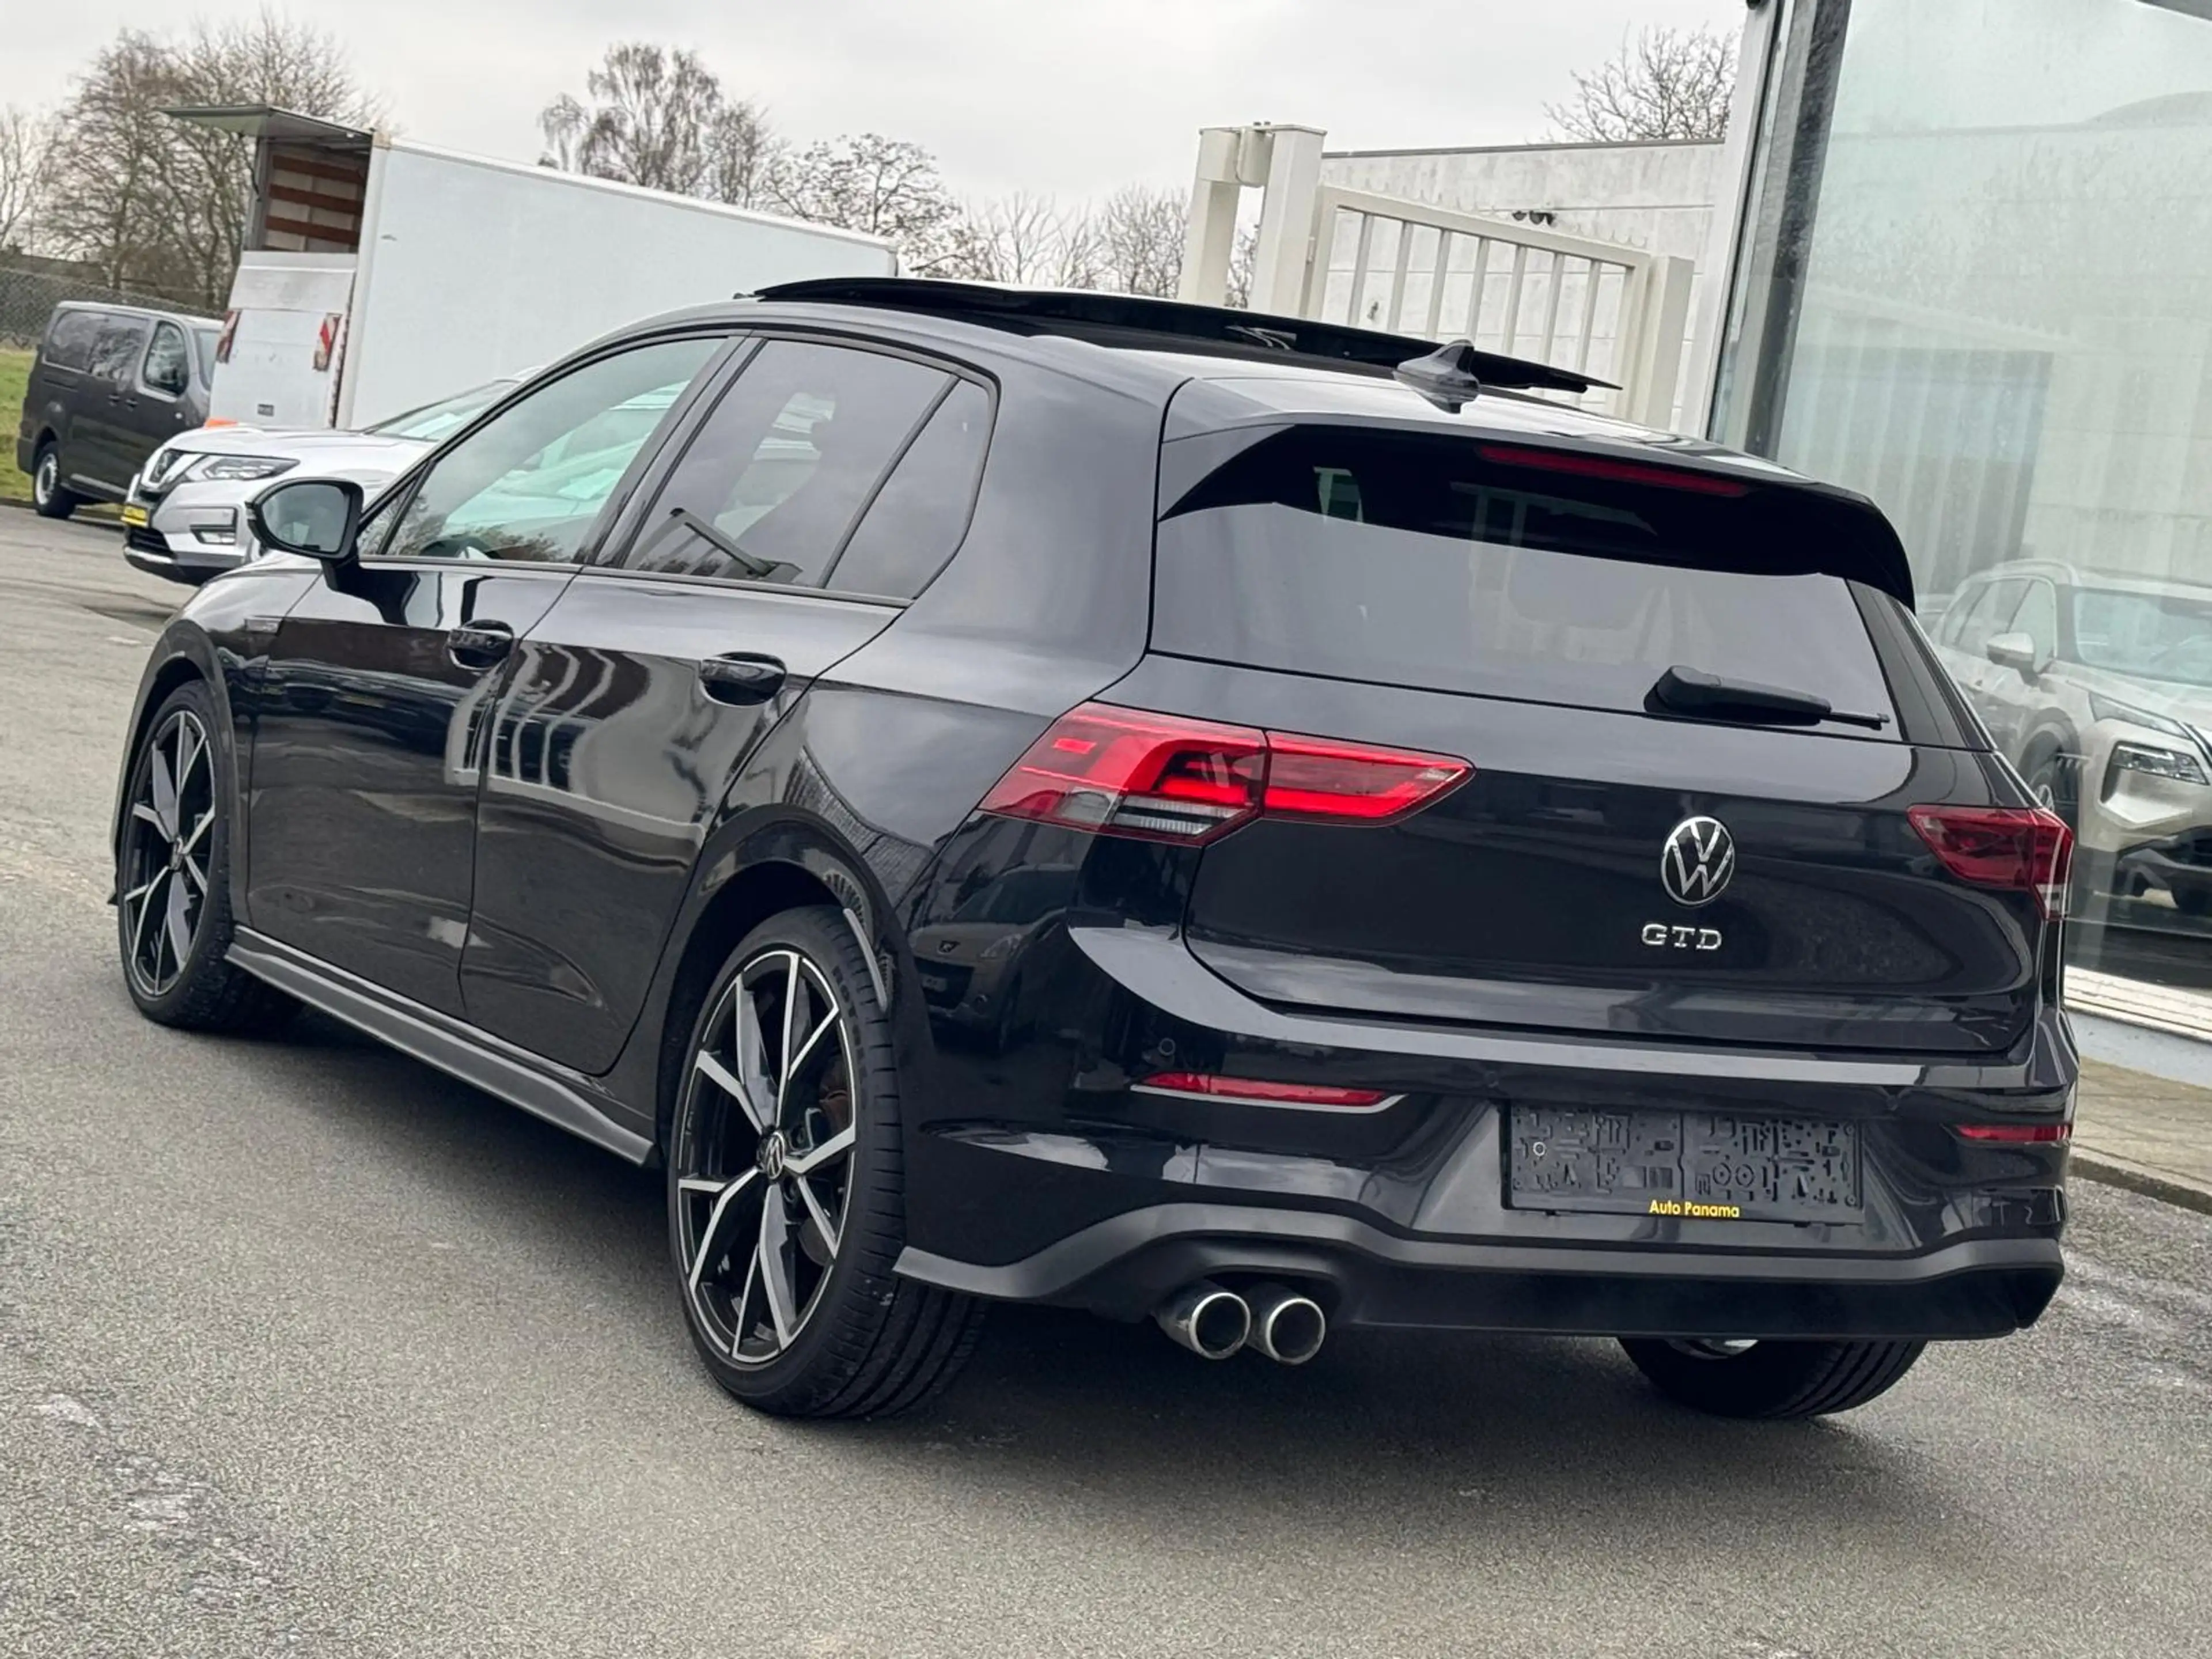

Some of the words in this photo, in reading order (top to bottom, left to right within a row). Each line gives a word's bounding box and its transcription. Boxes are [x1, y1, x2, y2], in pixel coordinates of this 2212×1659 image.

[1642, 923, 1723, 950] GTD
[1649, 1200, 1681, 1215] Auto
[1684, 1201, 1740, 1218] Panama
